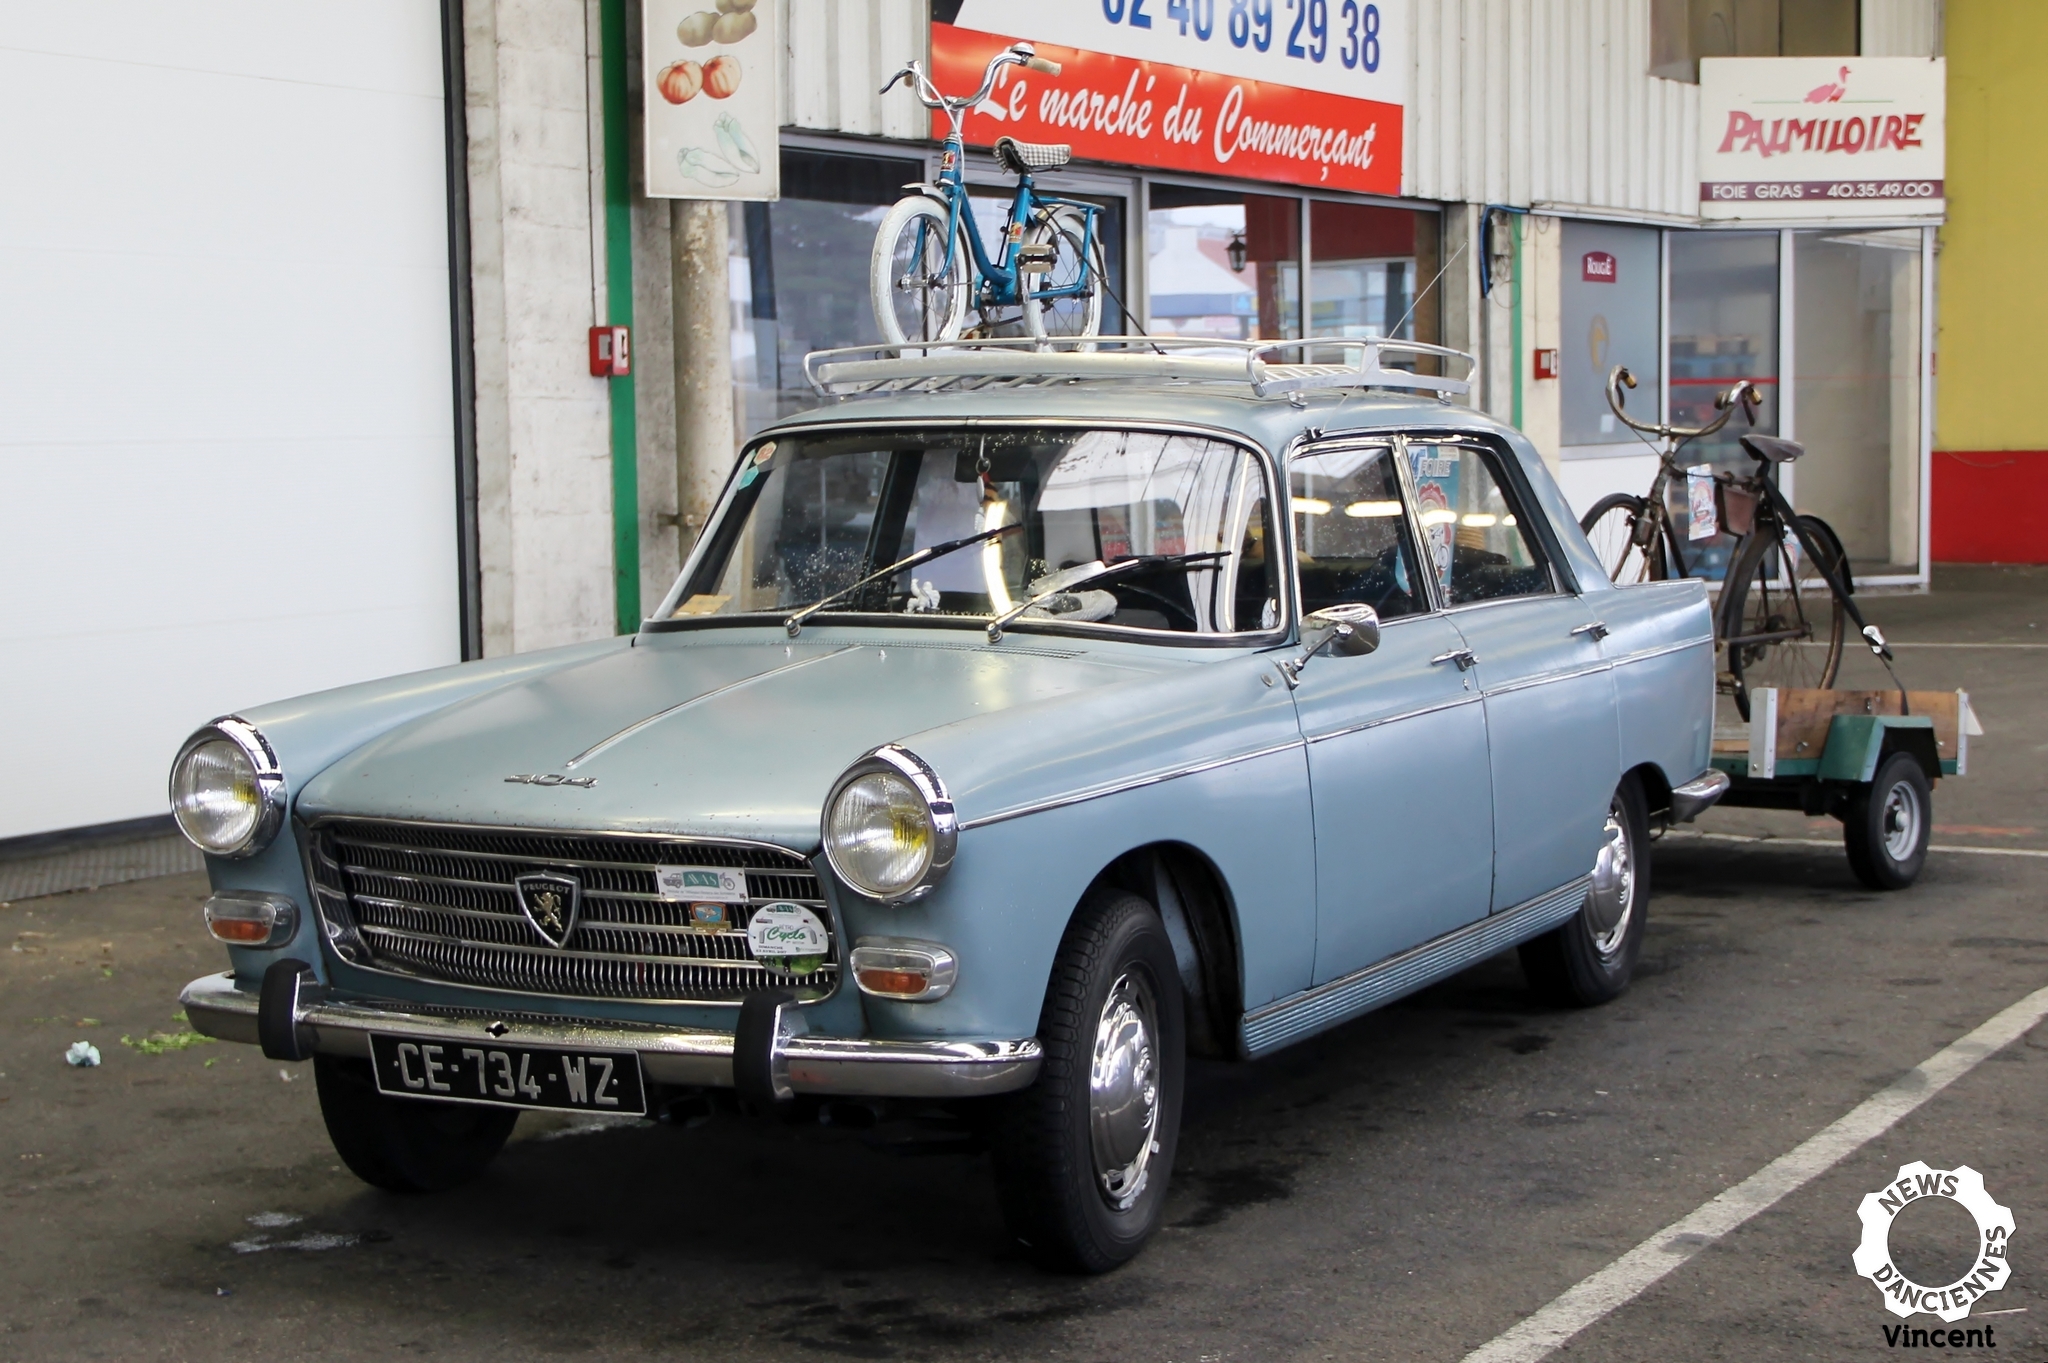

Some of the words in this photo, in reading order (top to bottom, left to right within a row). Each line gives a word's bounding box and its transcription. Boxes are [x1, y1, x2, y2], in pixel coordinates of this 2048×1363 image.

[1229, 0, 1272, 52] 89
[1286, 0, 1328, 63] 29
[1340, 0, 1380, 73] 38
[974, 57, 1027, 122] Le
[1039, 68, 1156, 139] marché
[1163, 83, 1204, 144] du
[1213, 84, 1379, 181] Commerçant
[1717, 111, 1926, 158] PALMILOIRE
[1712, 185, 1747, 199] FOIE
[1754, 184, 1804, 199] GRAS
[1827, 183, 1935, 198] 40.35.49.00
[1421, 459, 1451, 477] FOIRE
[504, 773, 599, 789] 404
[523, 882, 570, 894] PEUGEOT
[768, 926, 806, 942] Cyclo
[397, 1042, 619, 1105] CE-734-WZ
